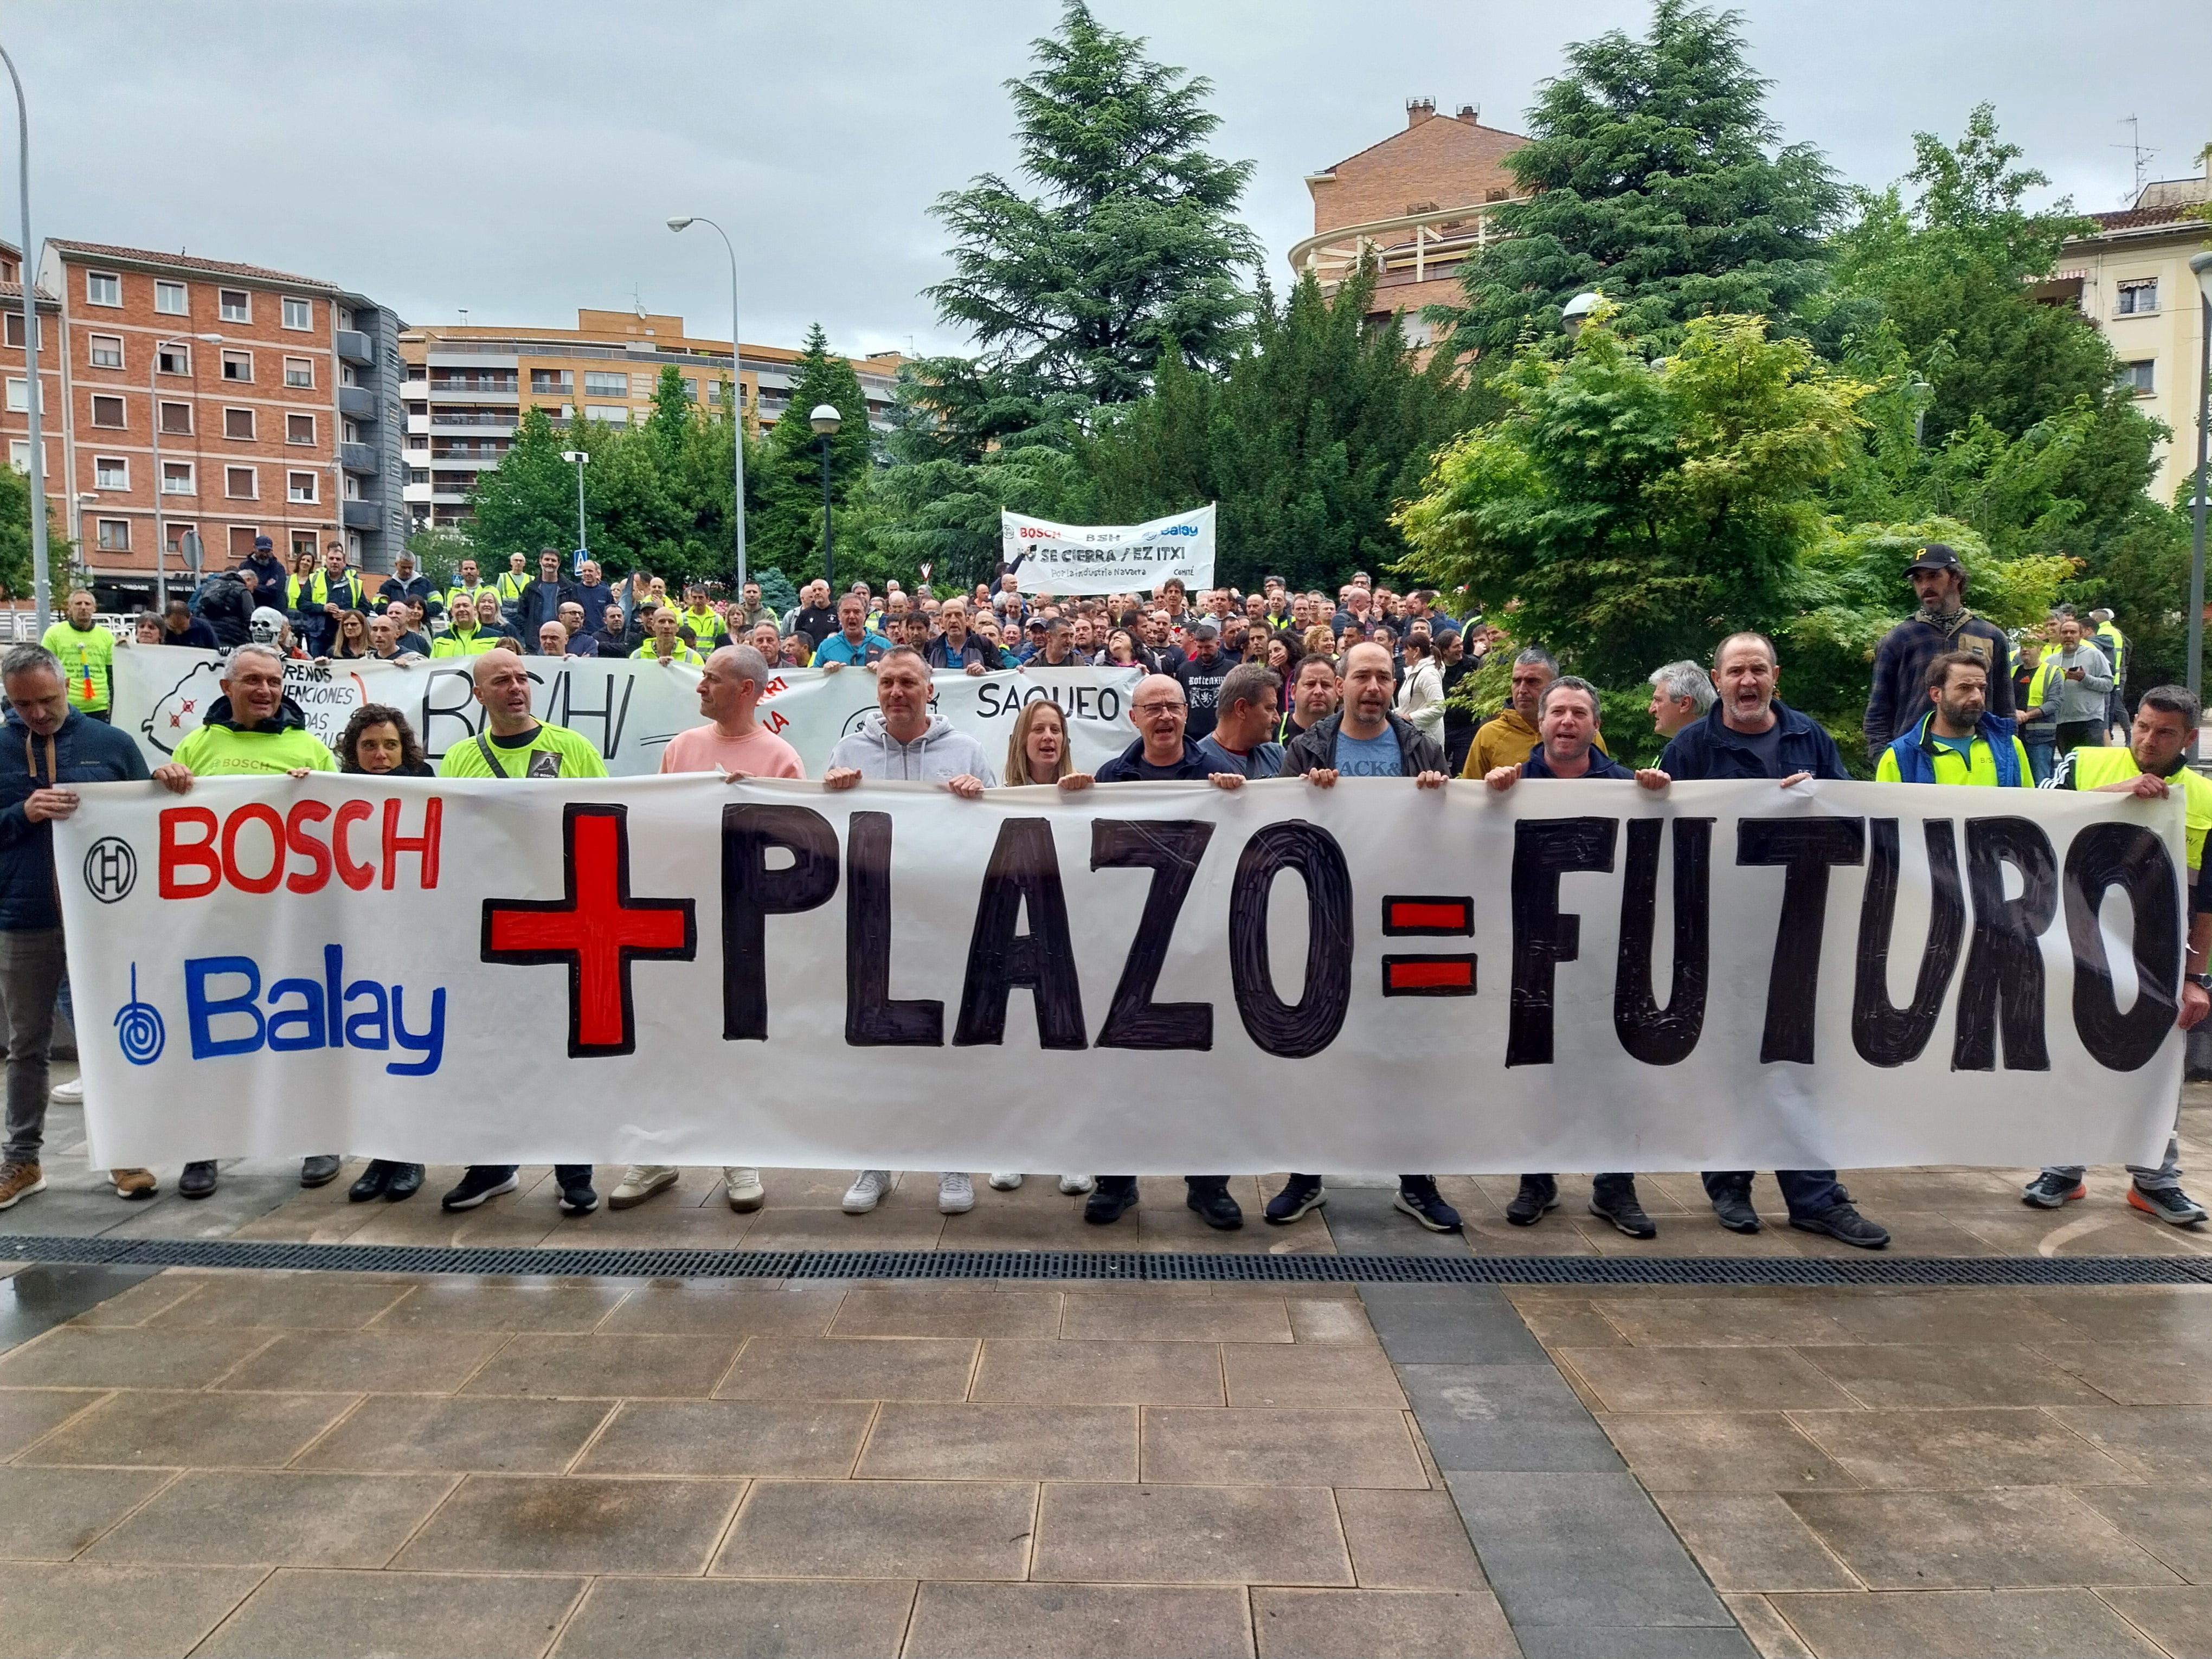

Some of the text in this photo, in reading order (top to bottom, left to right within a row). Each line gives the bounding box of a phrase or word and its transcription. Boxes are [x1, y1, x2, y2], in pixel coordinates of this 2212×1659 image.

[1020, 527, 1061, 539] BOSCH
[1085, 533, 1121, 542] BSH
[1040, 549, 1058, 562] SE
[1061, 549, 1117, 563] CIERRA
[1121, 548, 1130, 562] /
[1134, 546, 1153, 561] EZ
[1157, 546, 1185, 561] ITXI
[1915, 548, 1927, 561] P
[1051, 568, 1066, 577] Por
[1075, 568, 1112, 577] industria
[1114, 568, 1147, 576] Navarra
[282, 665, 332, 684] RENOS
[304, 712, 330, 730] DAS
[222, 758, 270, 771] BOSCH
[159, 797, 442, 899] BOSCH
[722, 803, 1353, 1058] PLAZO
[1506, 816, 2181, 1072] FUTURO
[184, 944, 446, 1076] Balay
